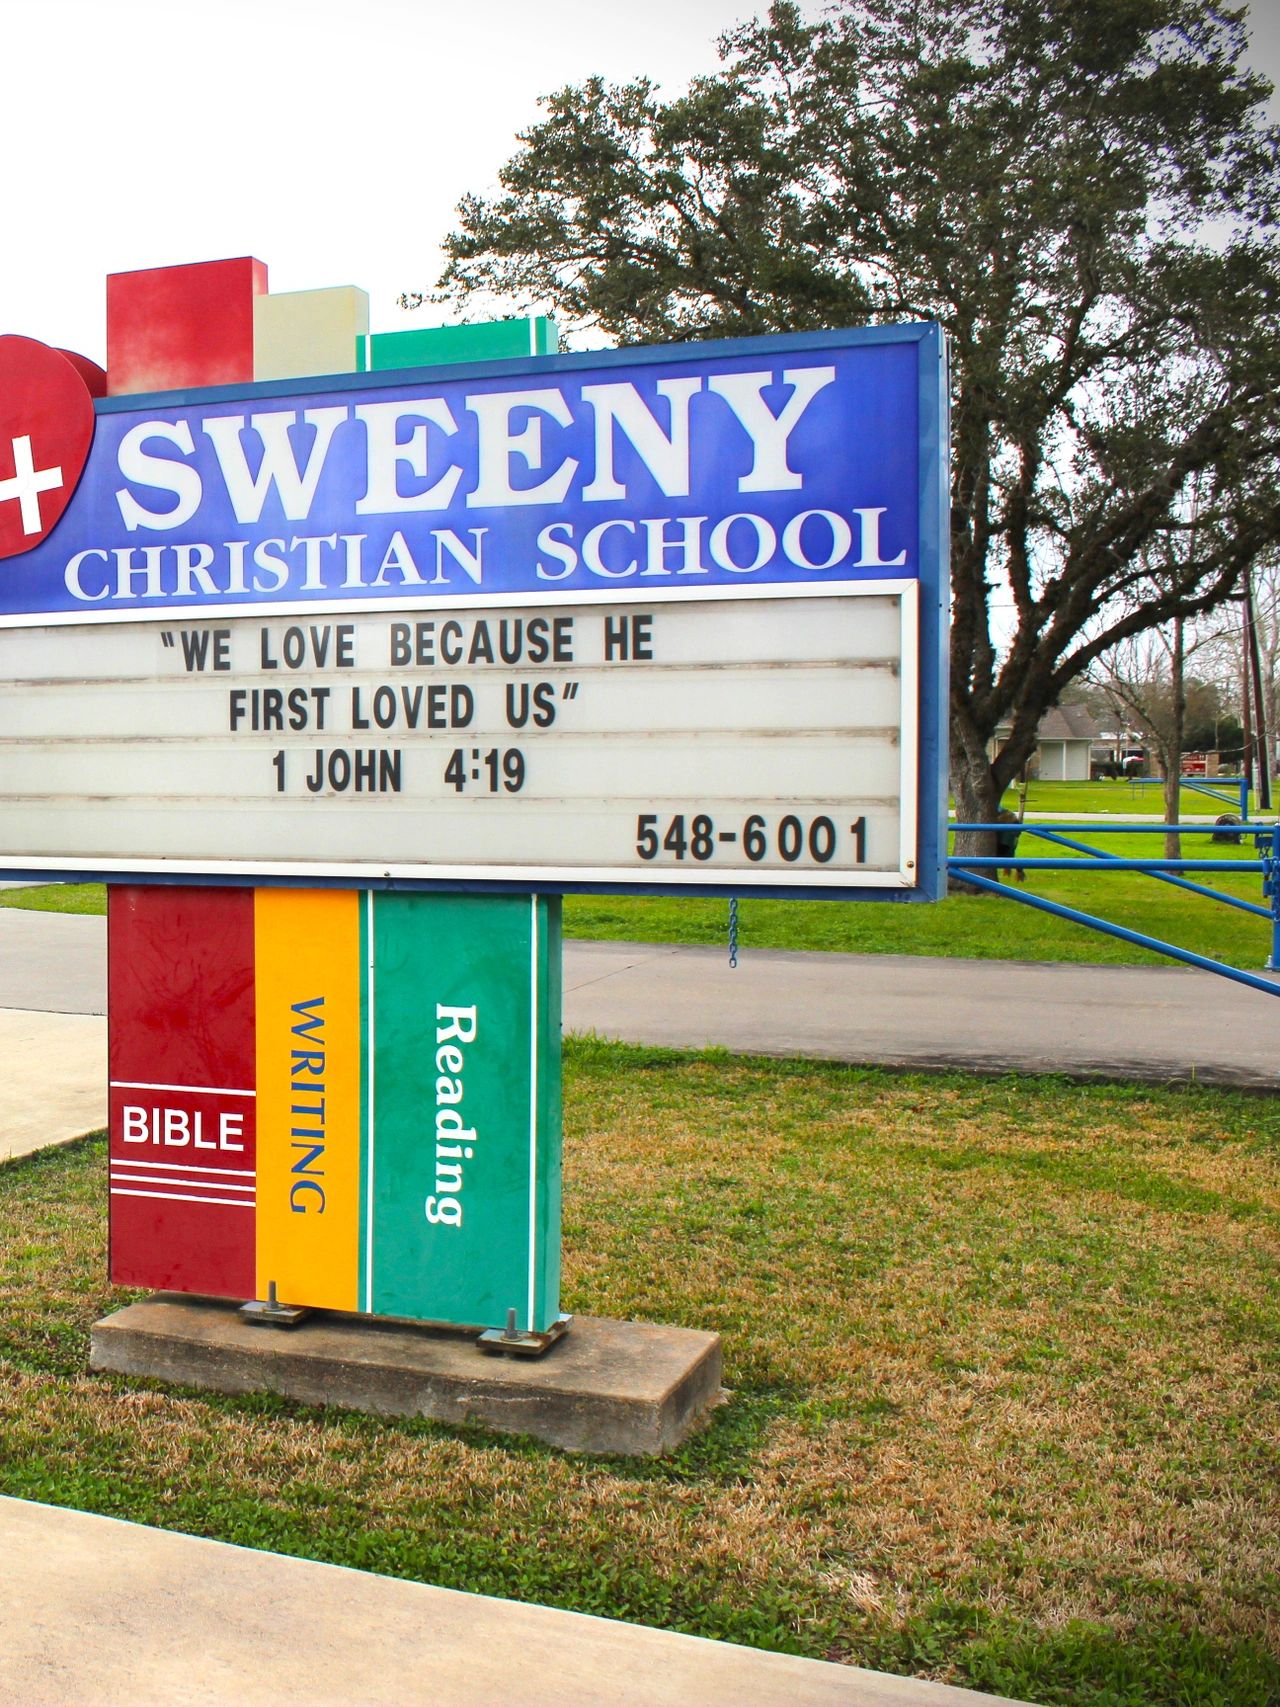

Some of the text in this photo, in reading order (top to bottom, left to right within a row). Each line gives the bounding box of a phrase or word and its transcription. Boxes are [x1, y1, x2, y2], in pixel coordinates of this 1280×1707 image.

[116, 366, 836, 532] SWEENY
[64, 507, 908, 601] CHRISTIAN SCHOOL
[161, 614, 654, 672] "WE LOVE BECAUSE HE
[229, 682, 579, 732] FIRST LOVED US"
[272, 747, 526, 793] 1 JOHN 4:19
[636, 813, 868, 863] 548-6001
[122, 1106, 245, 1152] BIBLE
[289, 996, 326, 1215] WRITING
[425, 1003, 477, 1228] Reading
